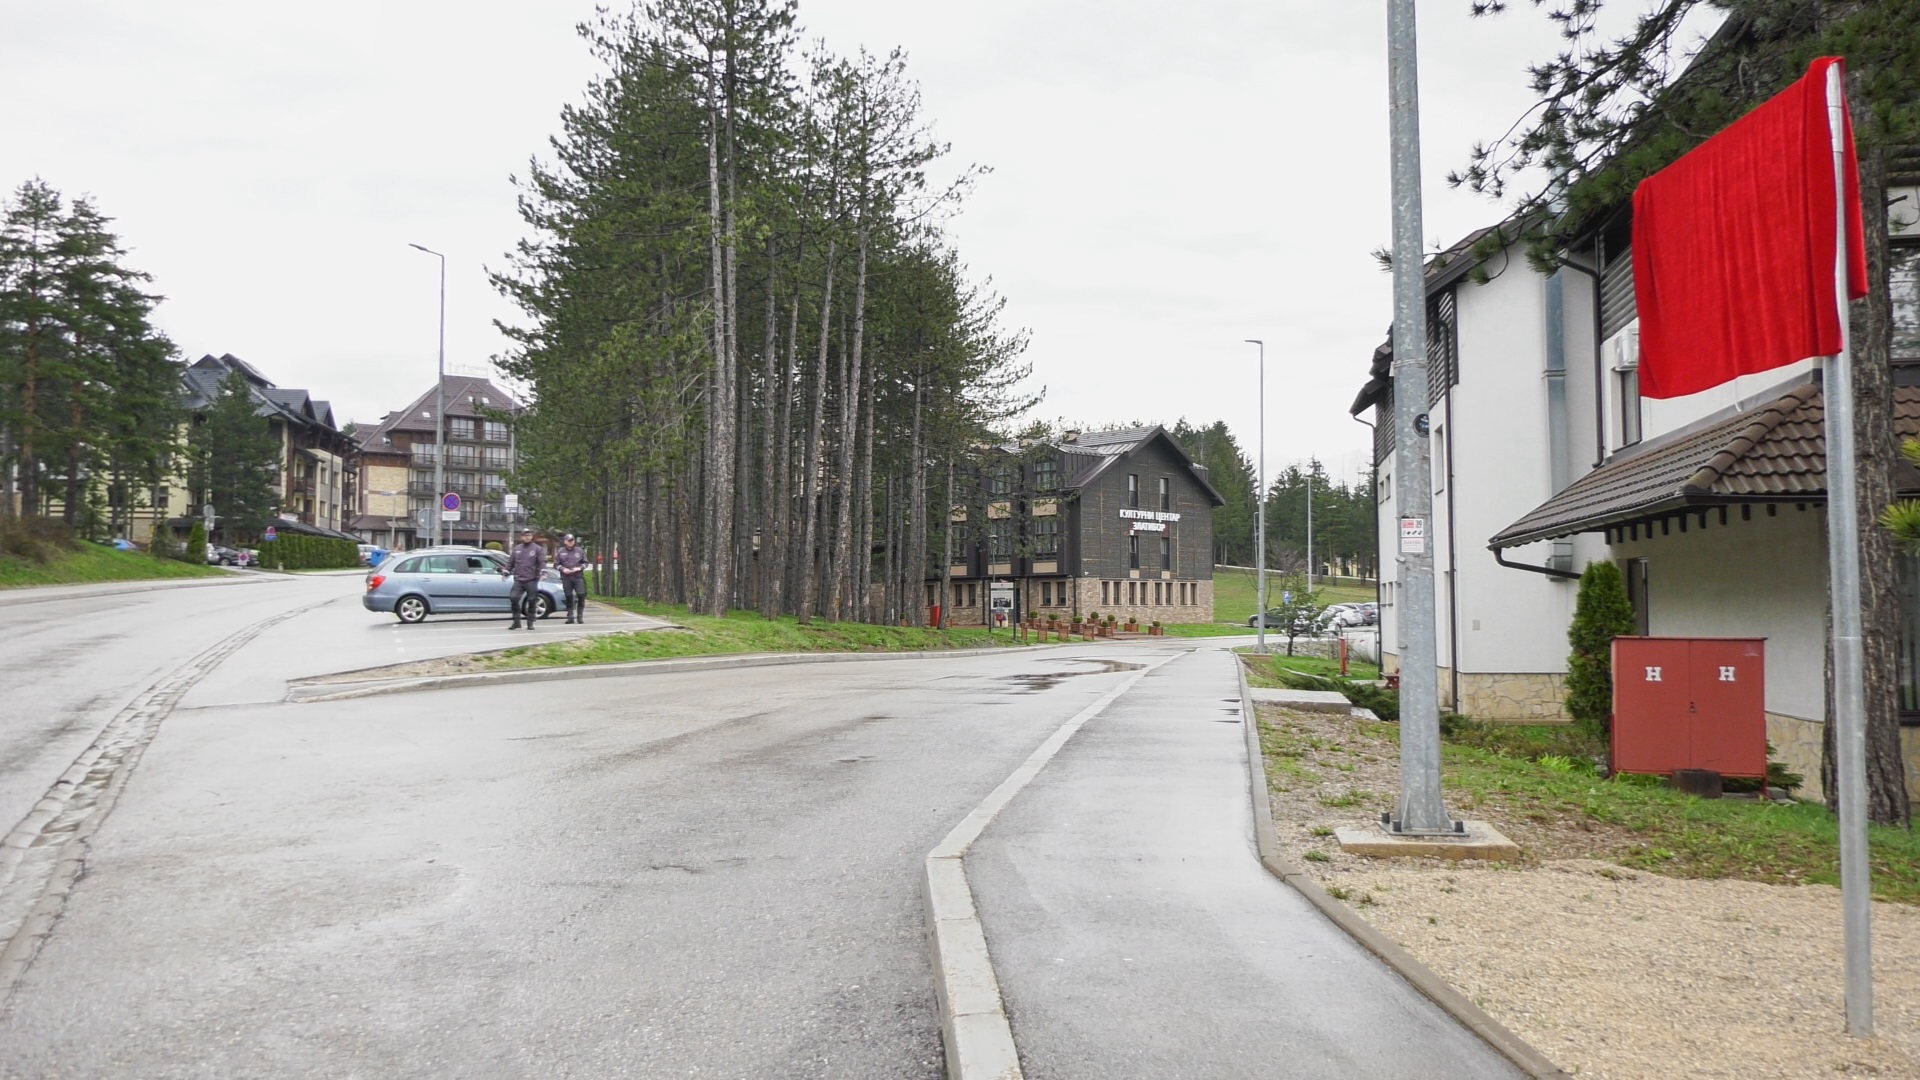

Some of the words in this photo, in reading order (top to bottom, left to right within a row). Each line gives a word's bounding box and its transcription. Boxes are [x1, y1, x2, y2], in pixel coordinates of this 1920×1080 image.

[1120, 509, 1154, 520] КУЛТУРНИ
[1155, 511, 1181, 523] ЦЕНТАР
[1132, 521, 1166, 532] ЗЛАТИБОР
[1645, 666, 1662, 682] H
[1718, 666, 1736, 682] H
